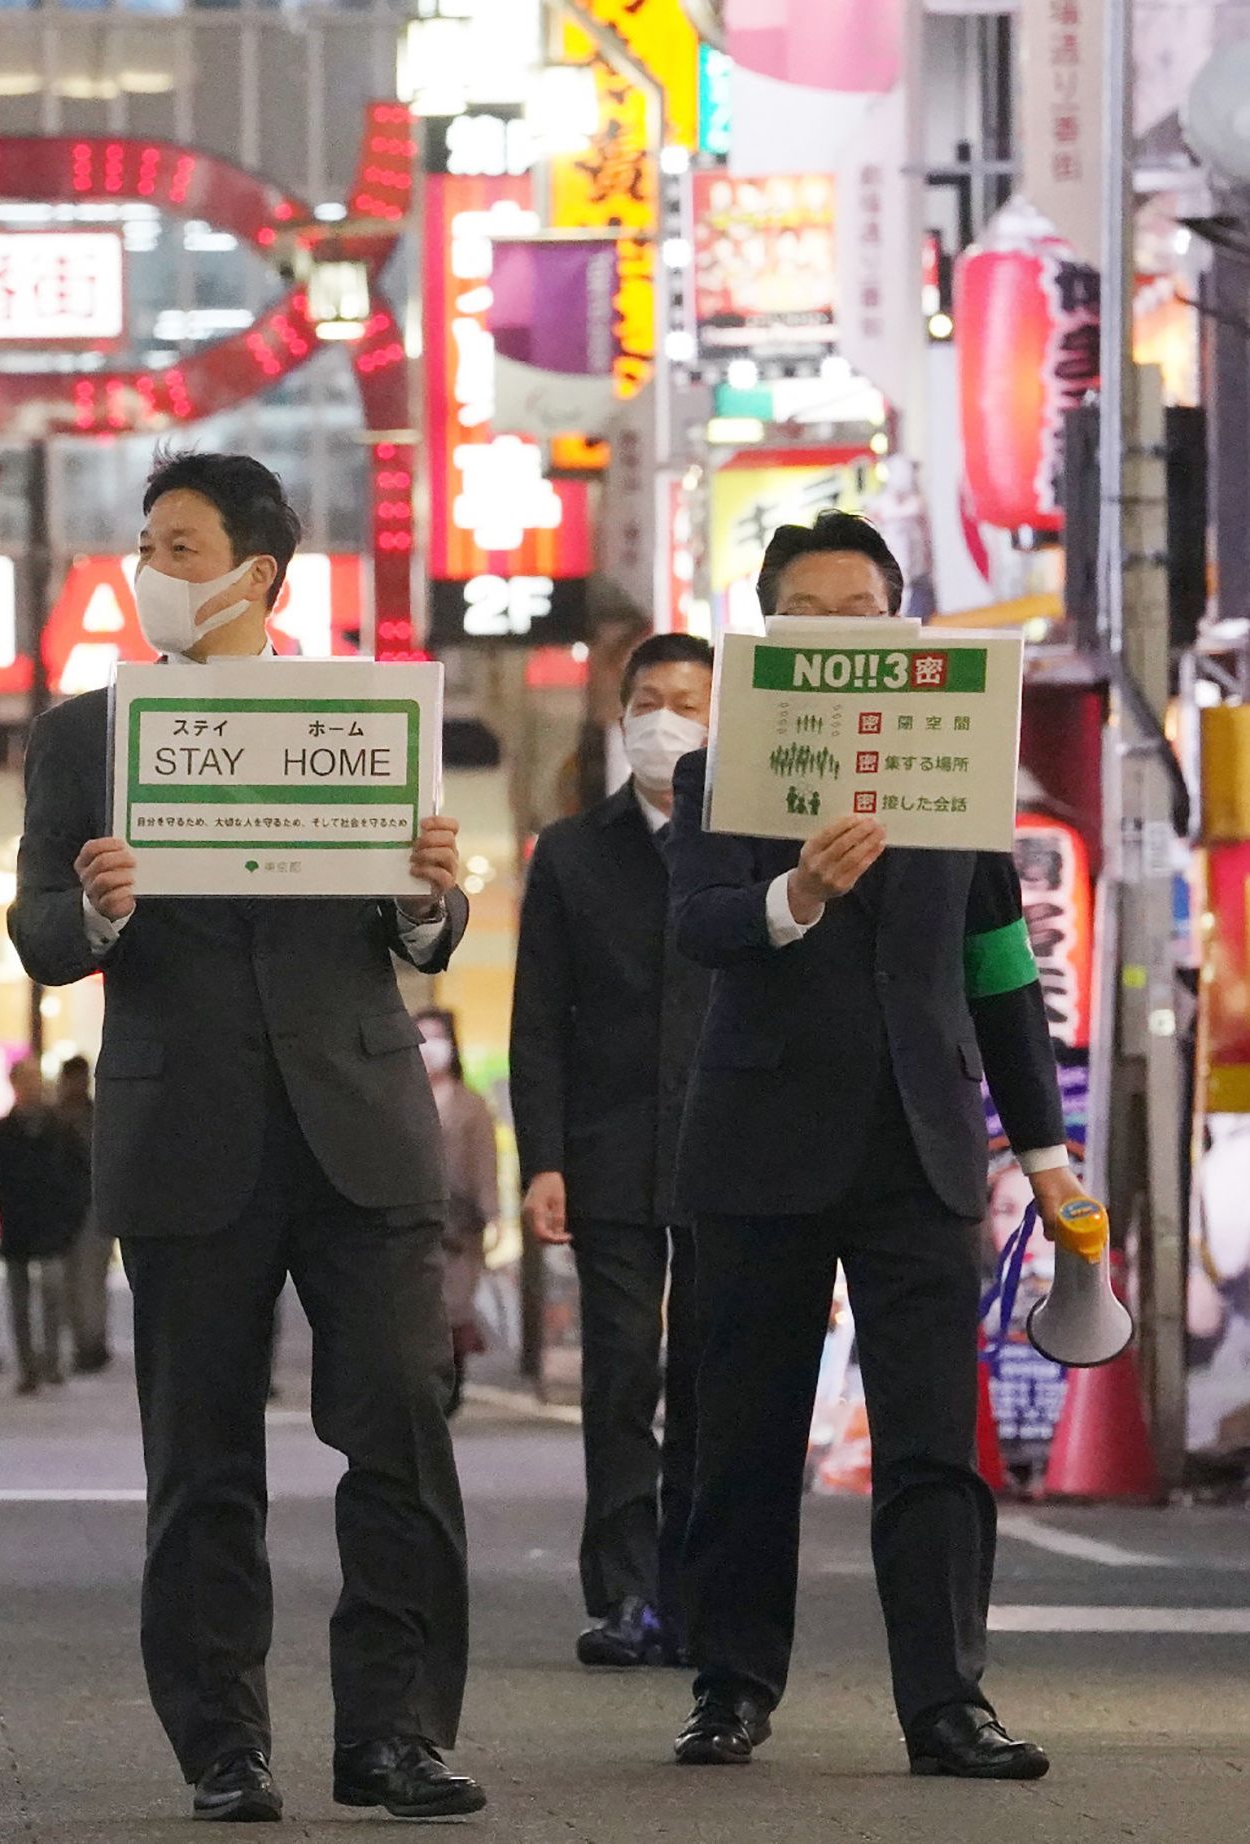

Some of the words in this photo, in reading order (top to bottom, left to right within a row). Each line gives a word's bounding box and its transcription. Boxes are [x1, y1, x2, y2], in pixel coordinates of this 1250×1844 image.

[463, 574, 553, 636] 2F
[173, 720, 228, 736] ステイ
[308, 721, 364, 737] ホーム
[154, 748, 245, 776] STAY
[283, 748, 391, 776] HOME
